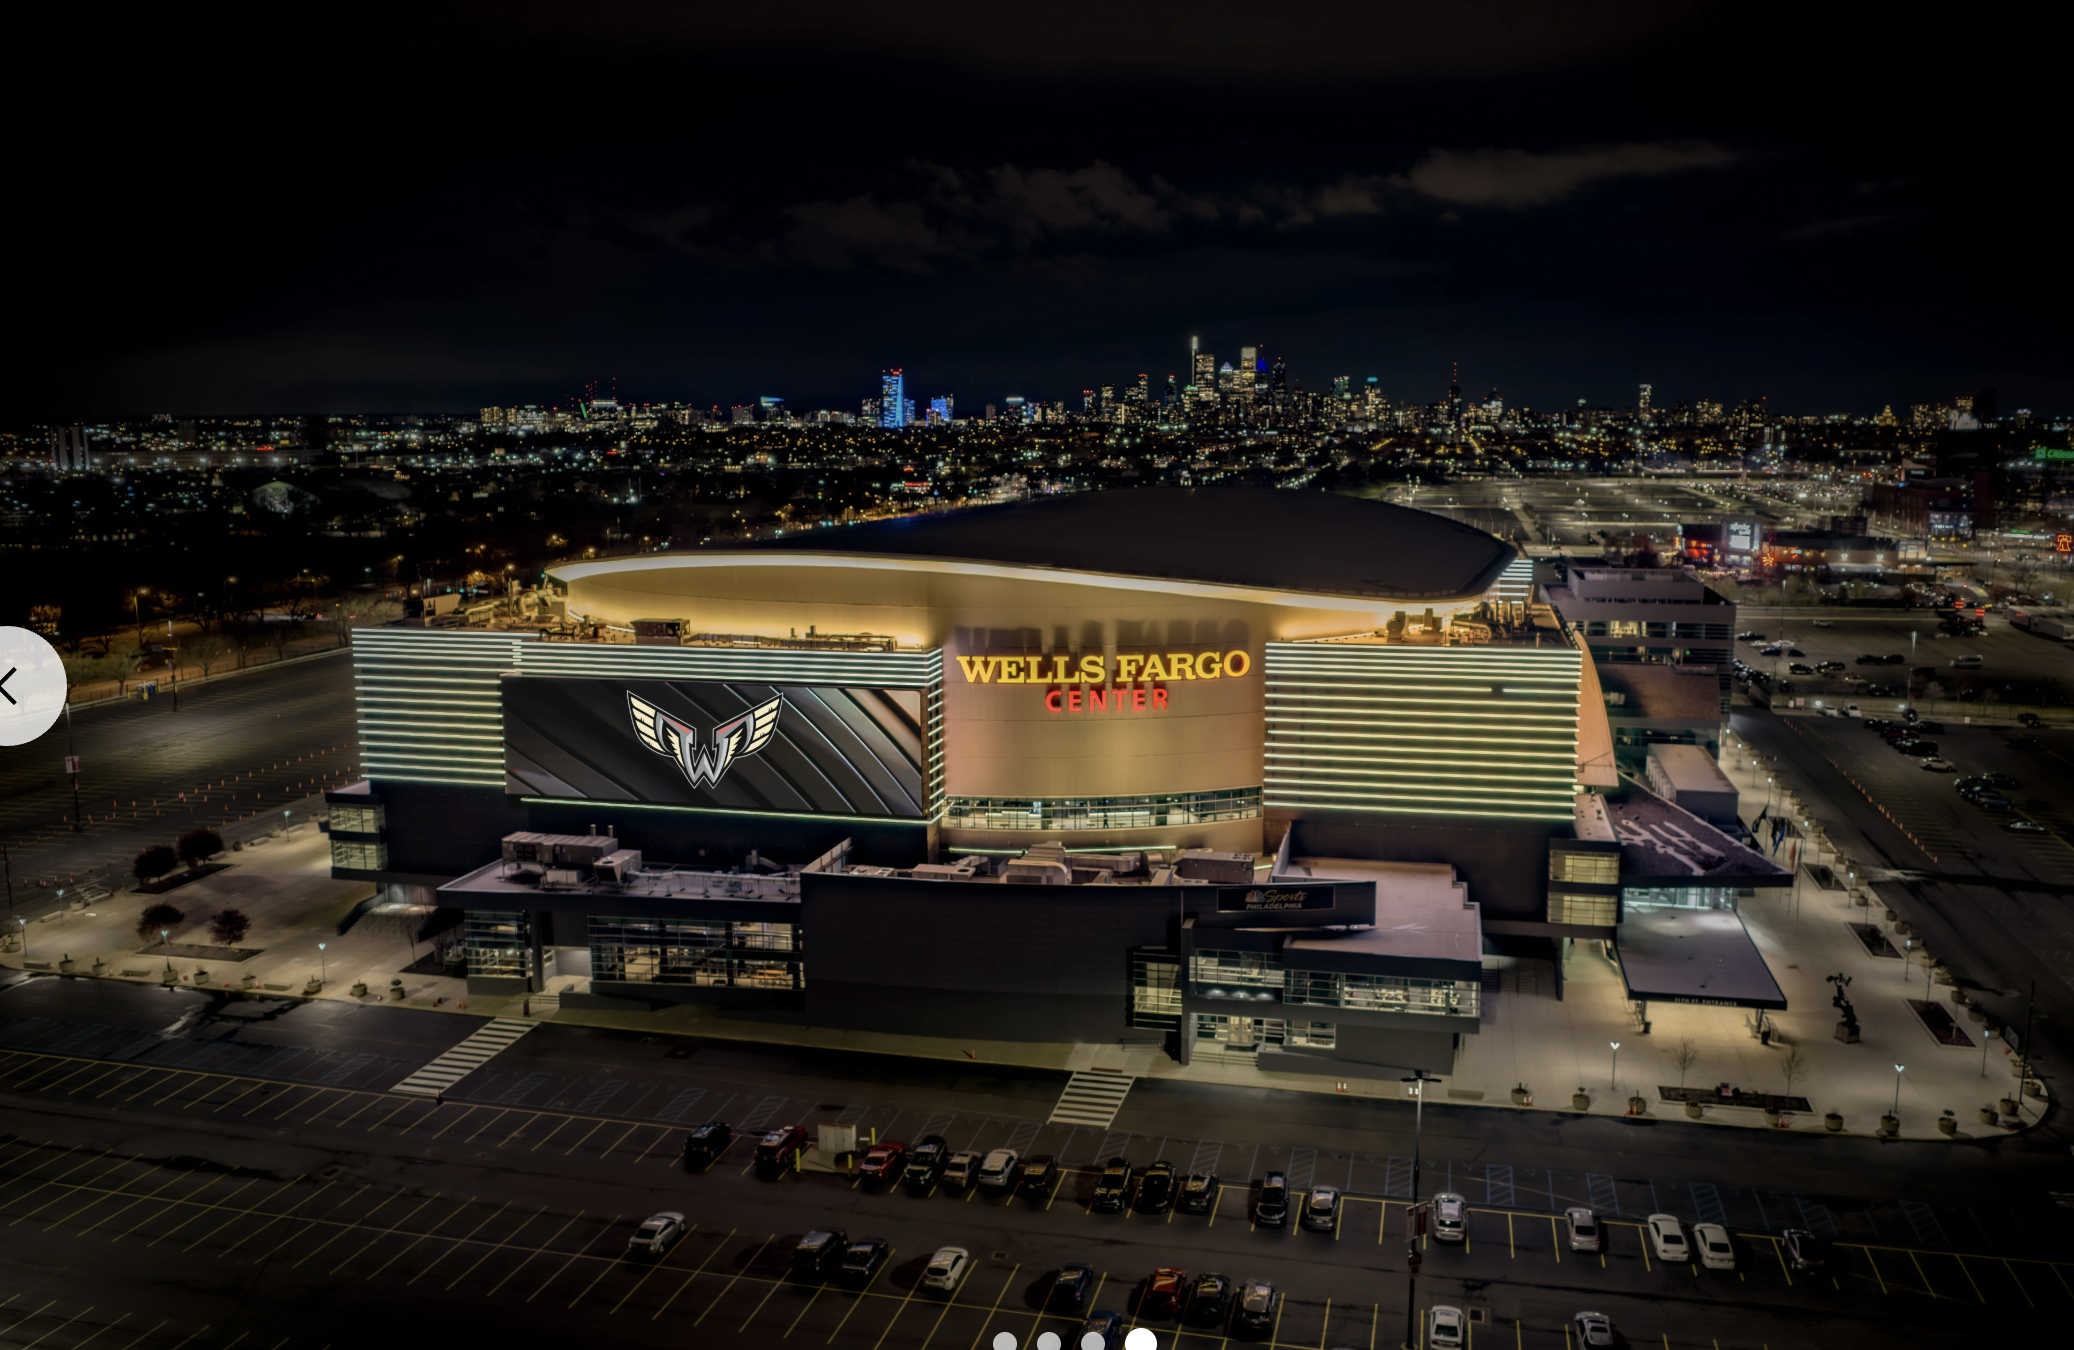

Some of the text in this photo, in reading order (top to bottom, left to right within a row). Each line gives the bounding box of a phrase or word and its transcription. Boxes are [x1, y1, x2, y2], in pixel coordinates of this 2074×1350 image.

[955, 650, 1251, 684] WELLS FARGO
[1045, 688, 1169, 713] CENTER
[1246, 902, 1302, 910] PHILADELPHIA
[1264, 889, 1307, 905] Sports
